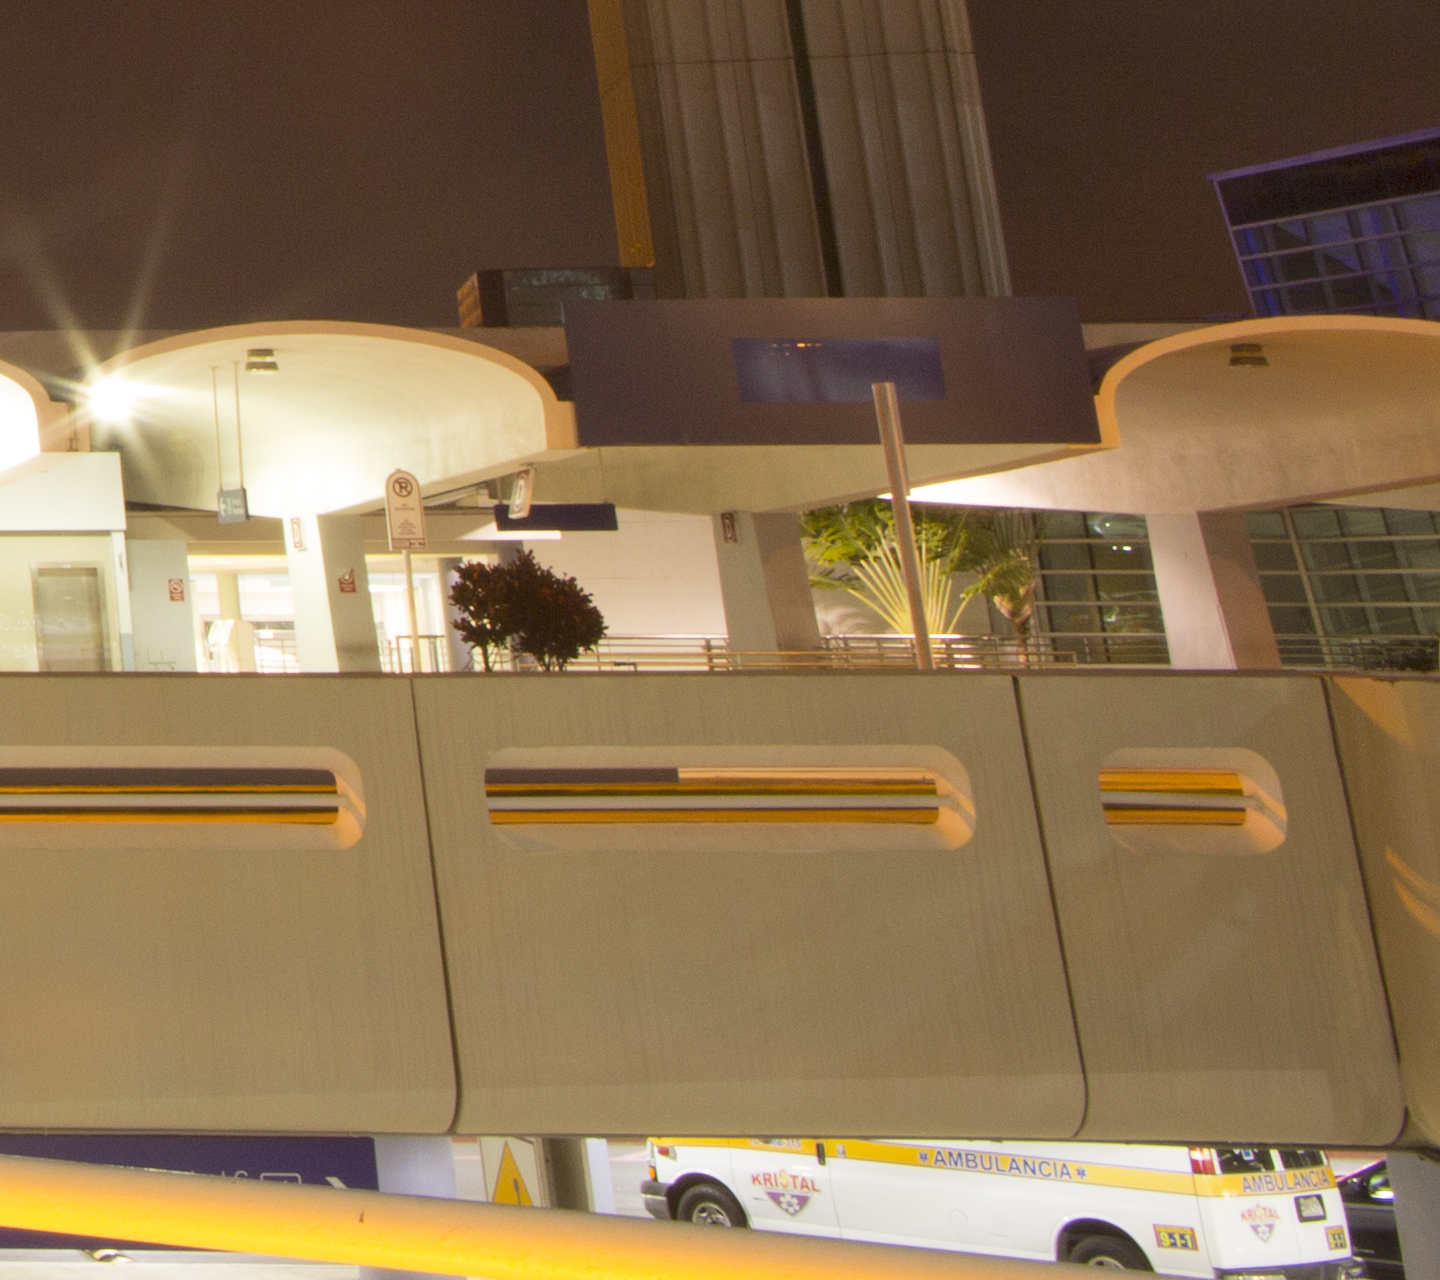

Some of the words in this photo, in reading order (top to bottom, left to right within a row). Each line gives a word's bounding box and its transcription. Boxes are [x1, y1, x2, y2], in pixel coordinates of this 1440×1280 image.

[933, 1150, 1072, 1179] AMBULANCIA
[751, 1169, 821, 1193] KRISTAL
[1242, 1169, 1330, 1193] AMBULANCIA
[1240, 1204, 1281, 1222] KRISTAL
[1160, 1231, 1193, 1248] 9-1-1
